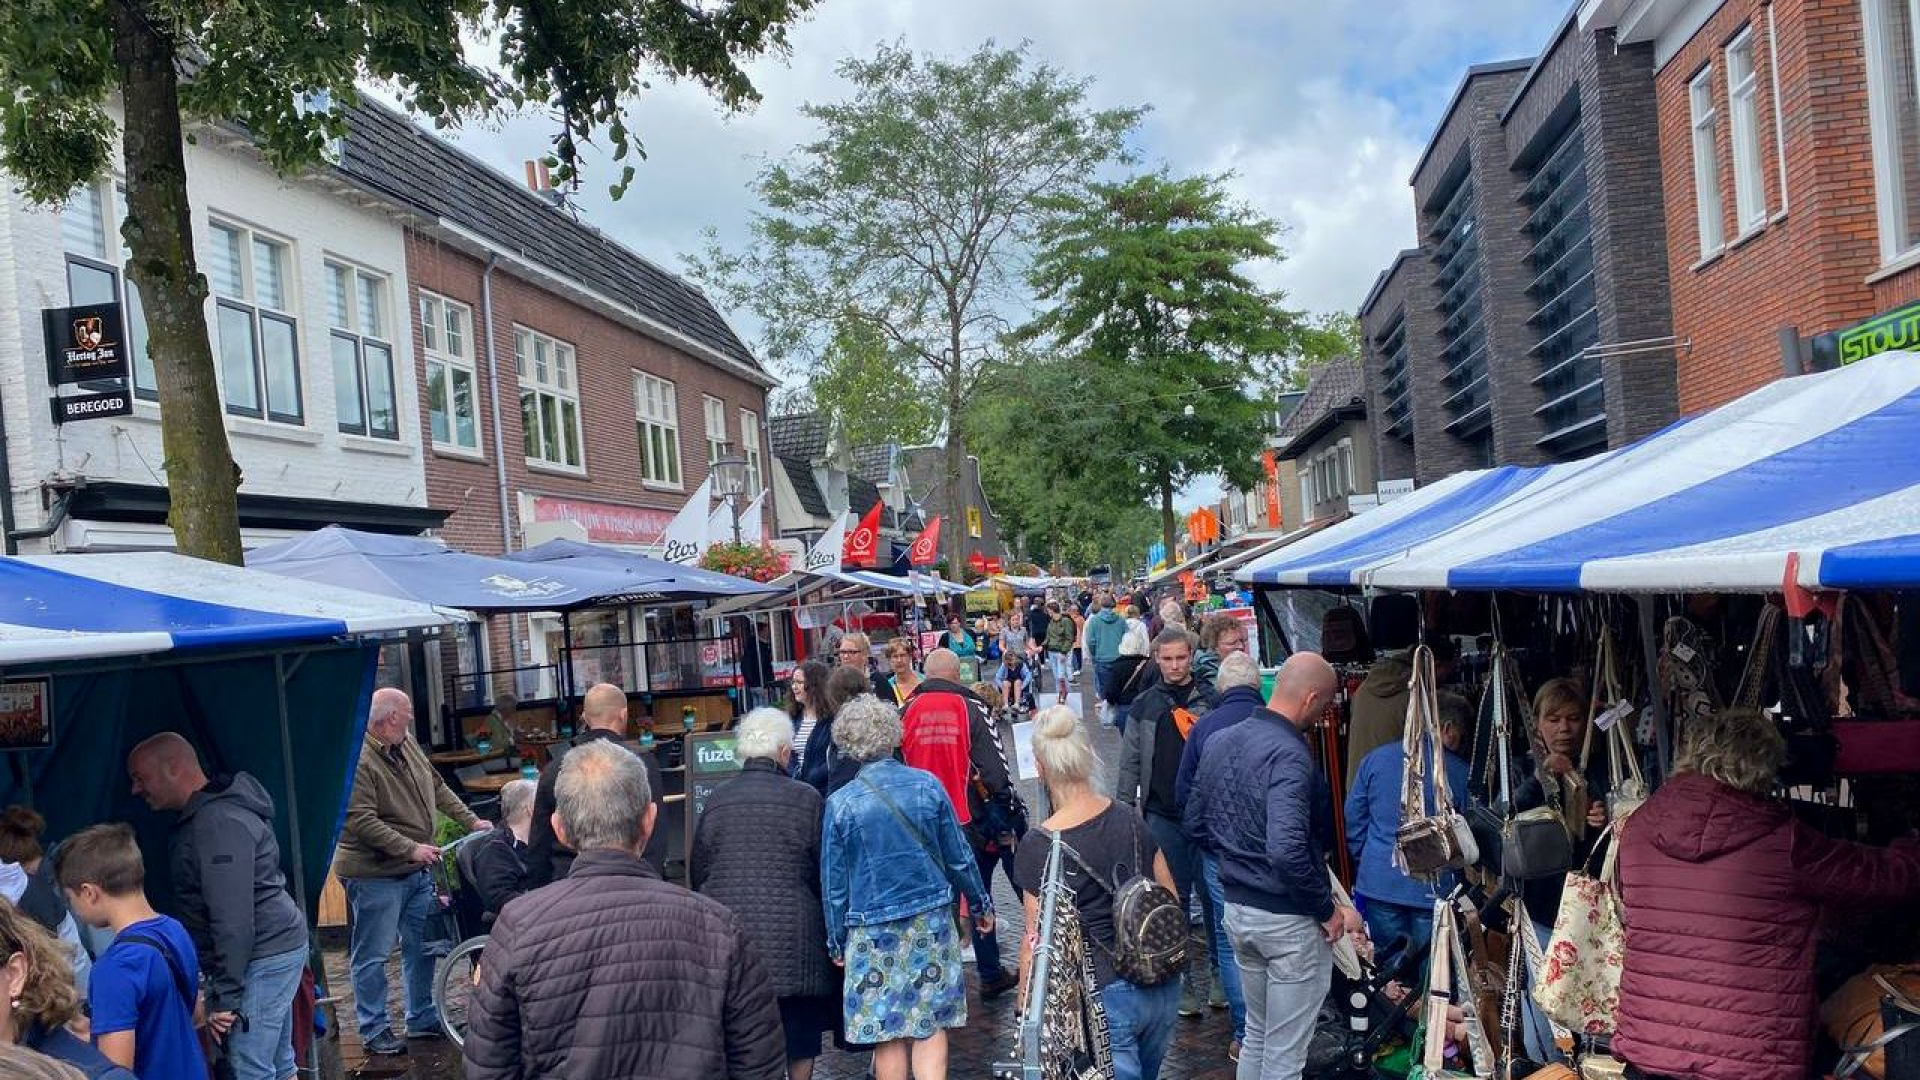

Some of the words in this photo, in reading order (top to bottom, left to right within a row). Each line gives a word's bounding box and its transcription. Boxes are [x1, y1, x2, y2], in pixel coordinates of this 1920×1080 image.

[66, 350, 97, 365] Hertog
[67, 398, 124, 414] BEREGOED
[663, 539, 699, 564] Etos
[808, 551, 835, 571] Etos
[697, 747, 734, 763] fuze
